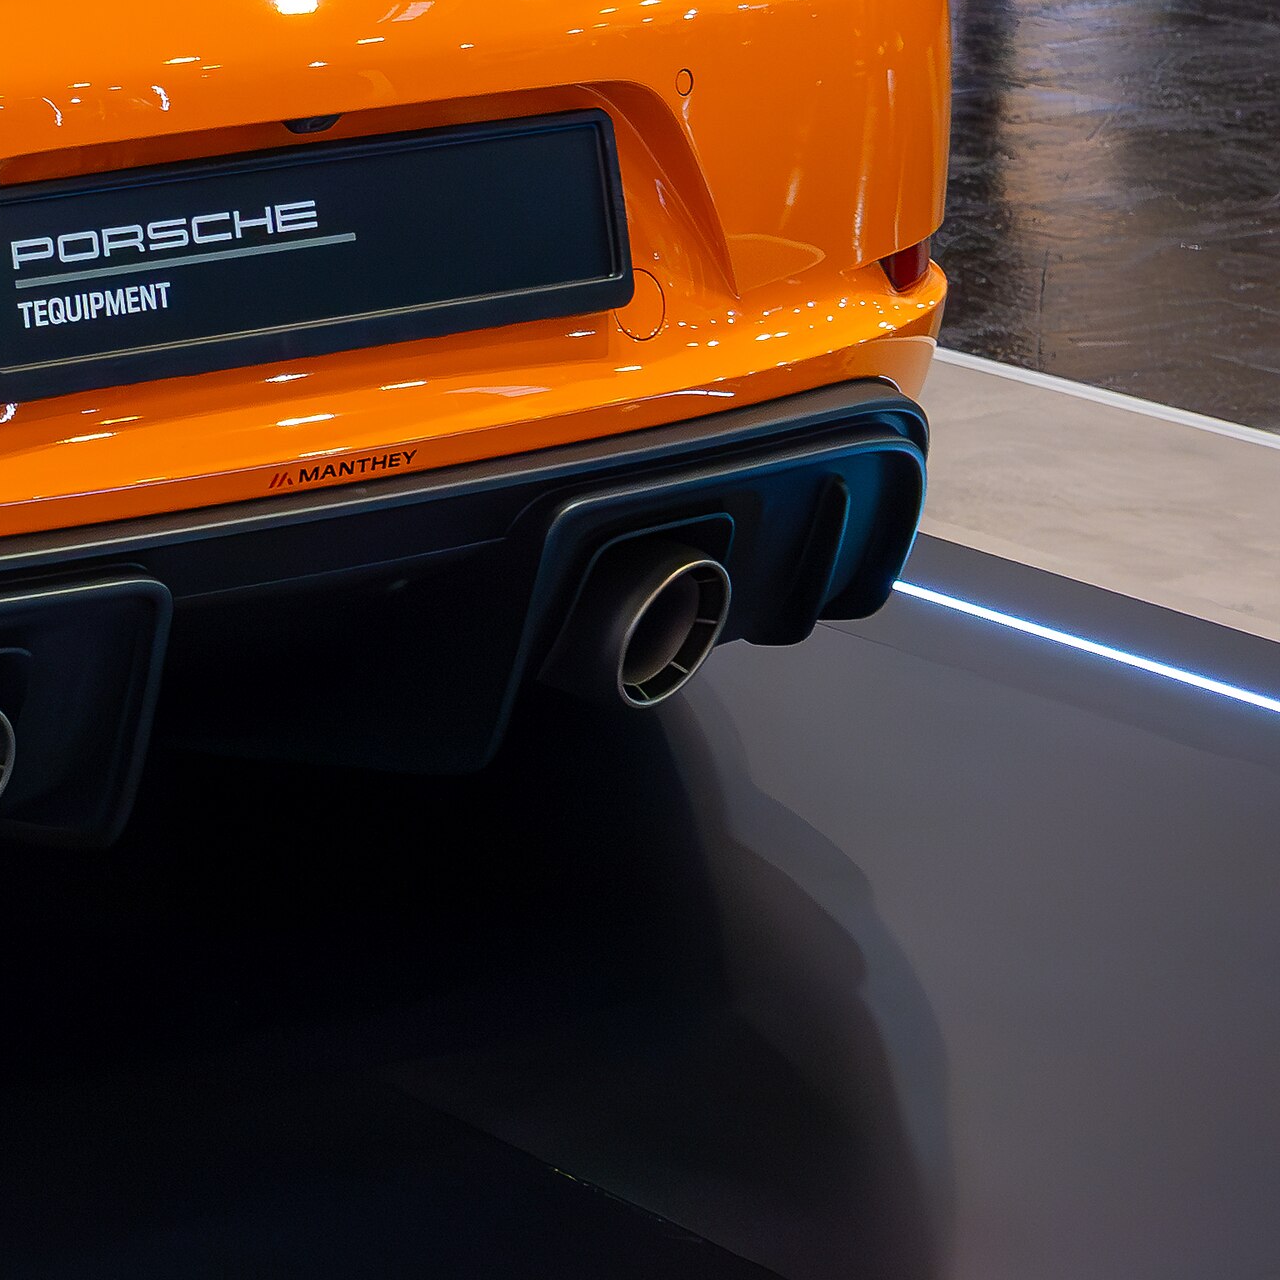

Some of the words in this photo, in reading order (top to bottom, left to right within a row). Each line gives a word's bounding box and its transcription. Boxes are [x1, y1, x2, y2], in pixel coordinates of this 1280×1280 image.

[10, 200, 319, 270] PORSCHE
[17, 282, 171, 329] TEQUIPMENT
[298, 449, 417, 483] MANTHEY
